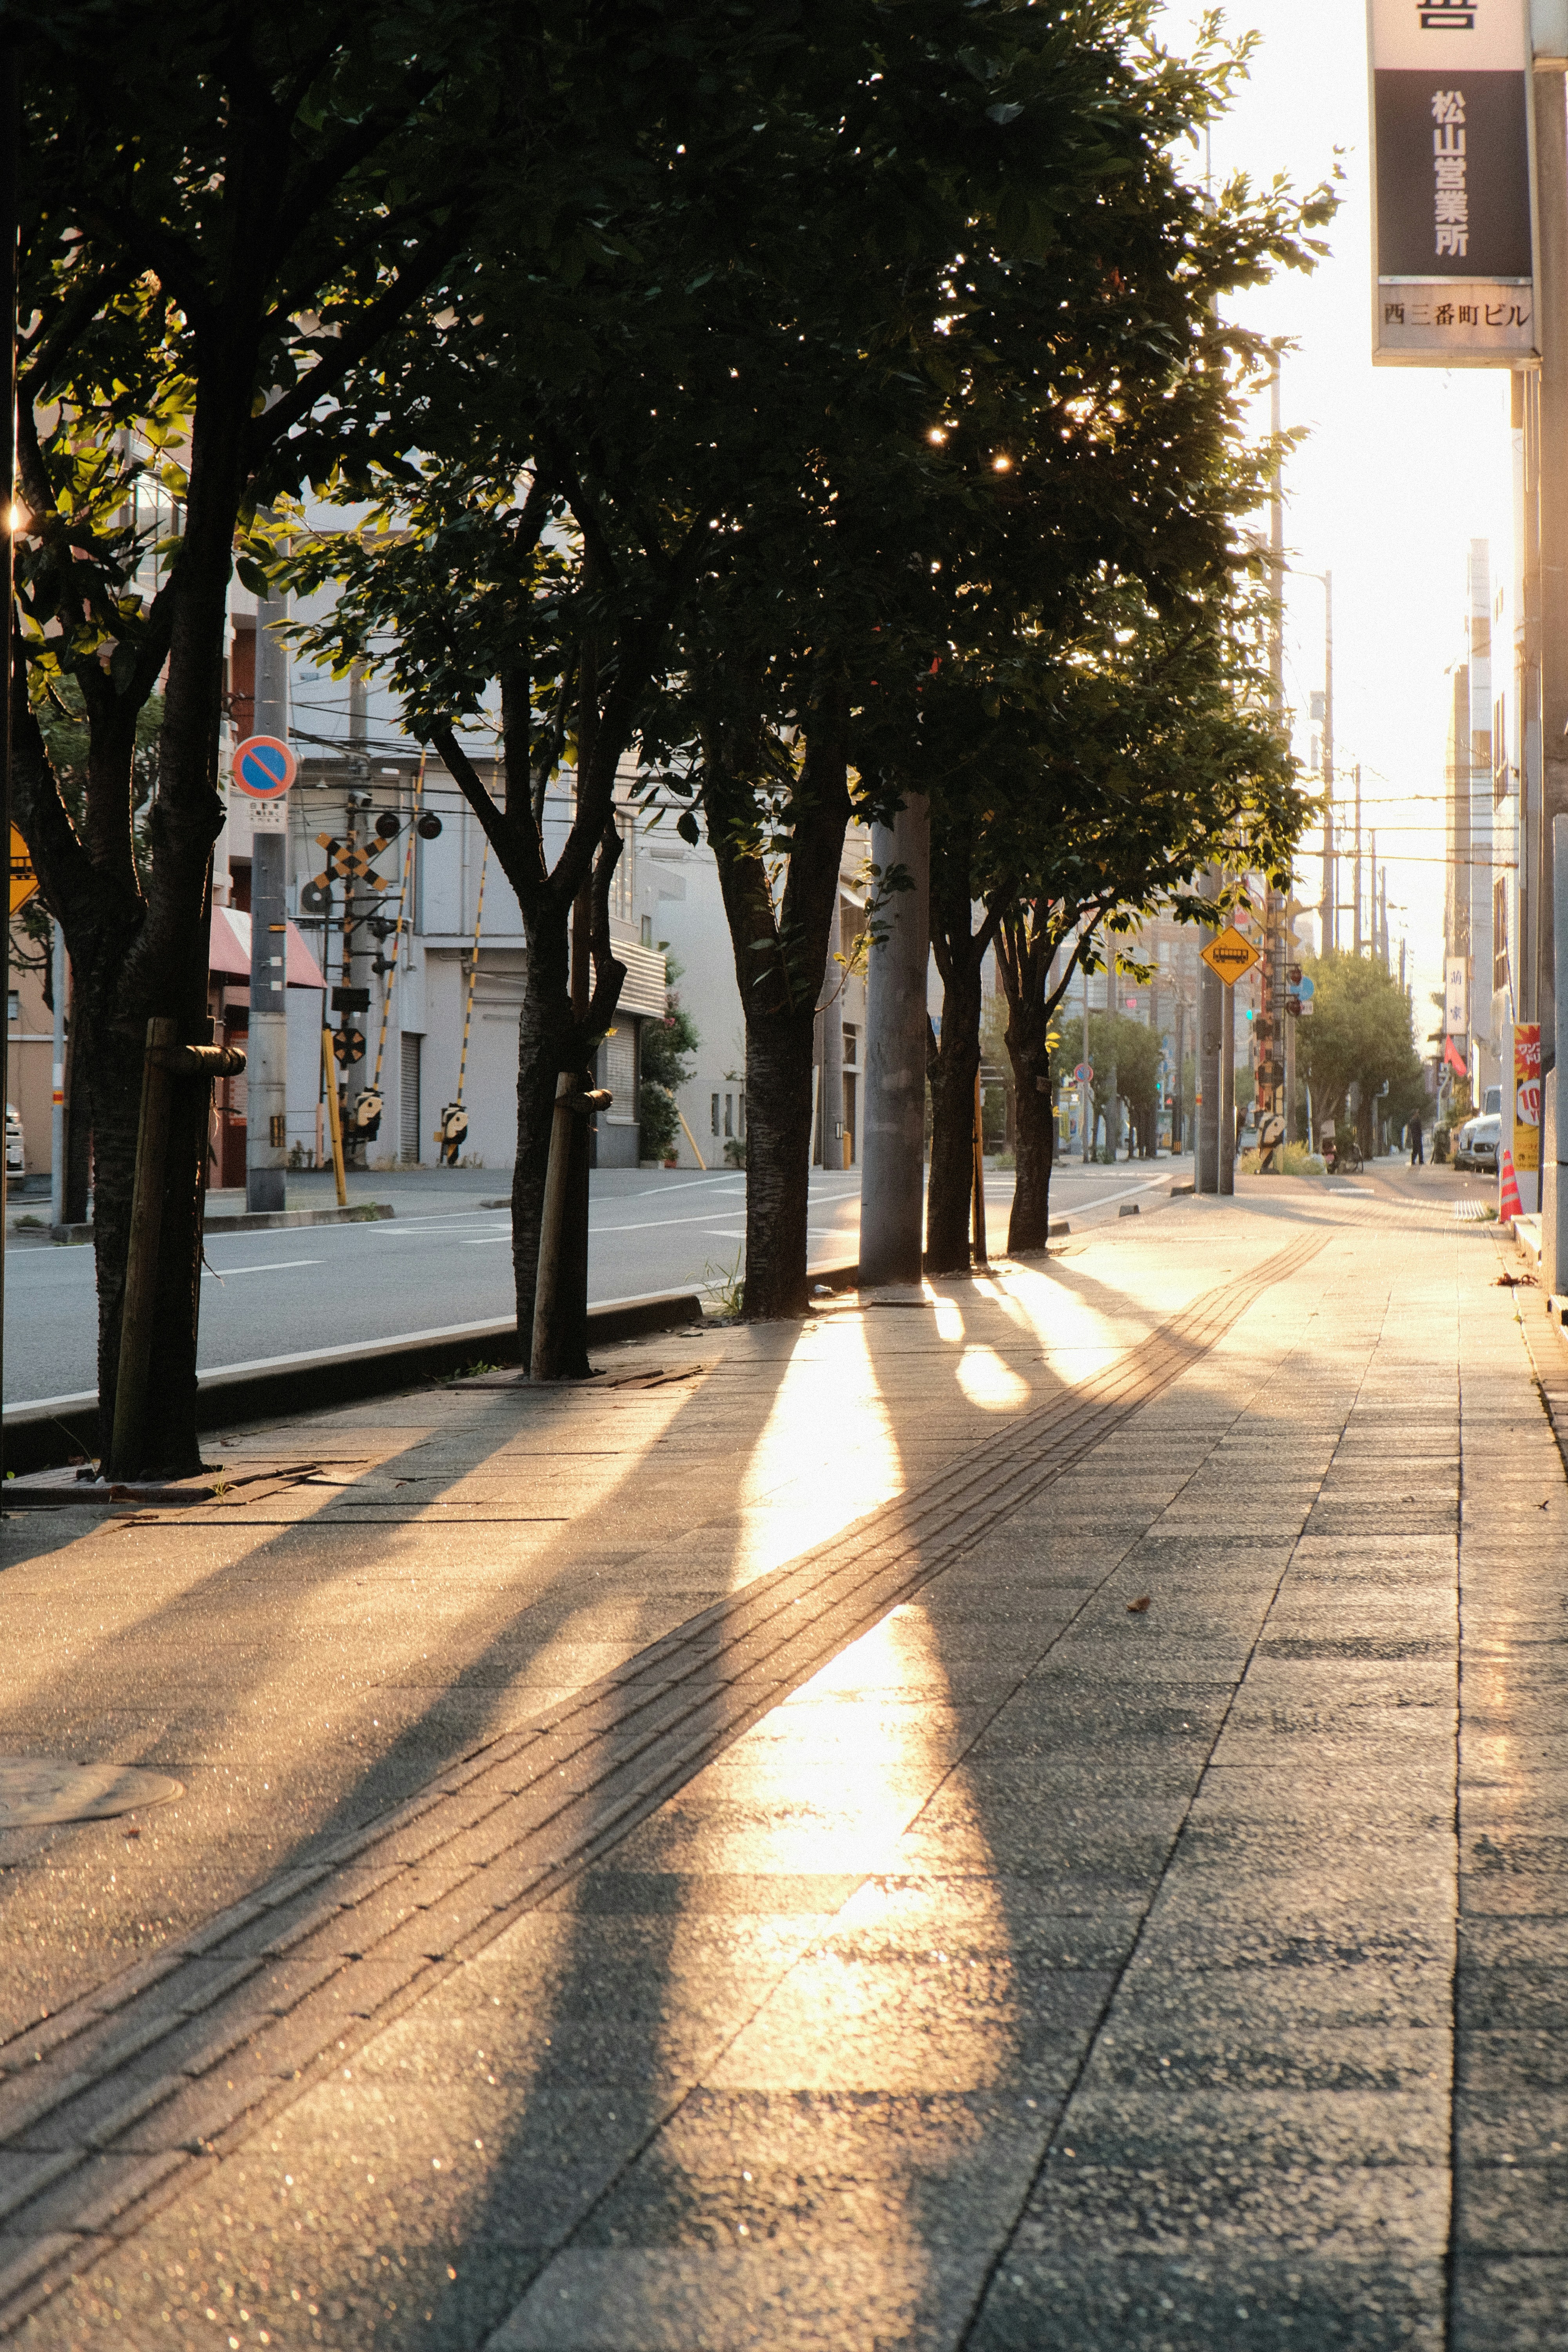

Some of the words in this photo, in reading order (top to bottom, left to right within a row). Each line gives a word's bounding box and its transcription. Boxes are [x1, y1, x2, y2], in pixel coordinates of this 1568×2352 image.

[1431, 90, 1469, 257] 松山営業所
[1384, 303, 1529, 327] 西三番町ビル
